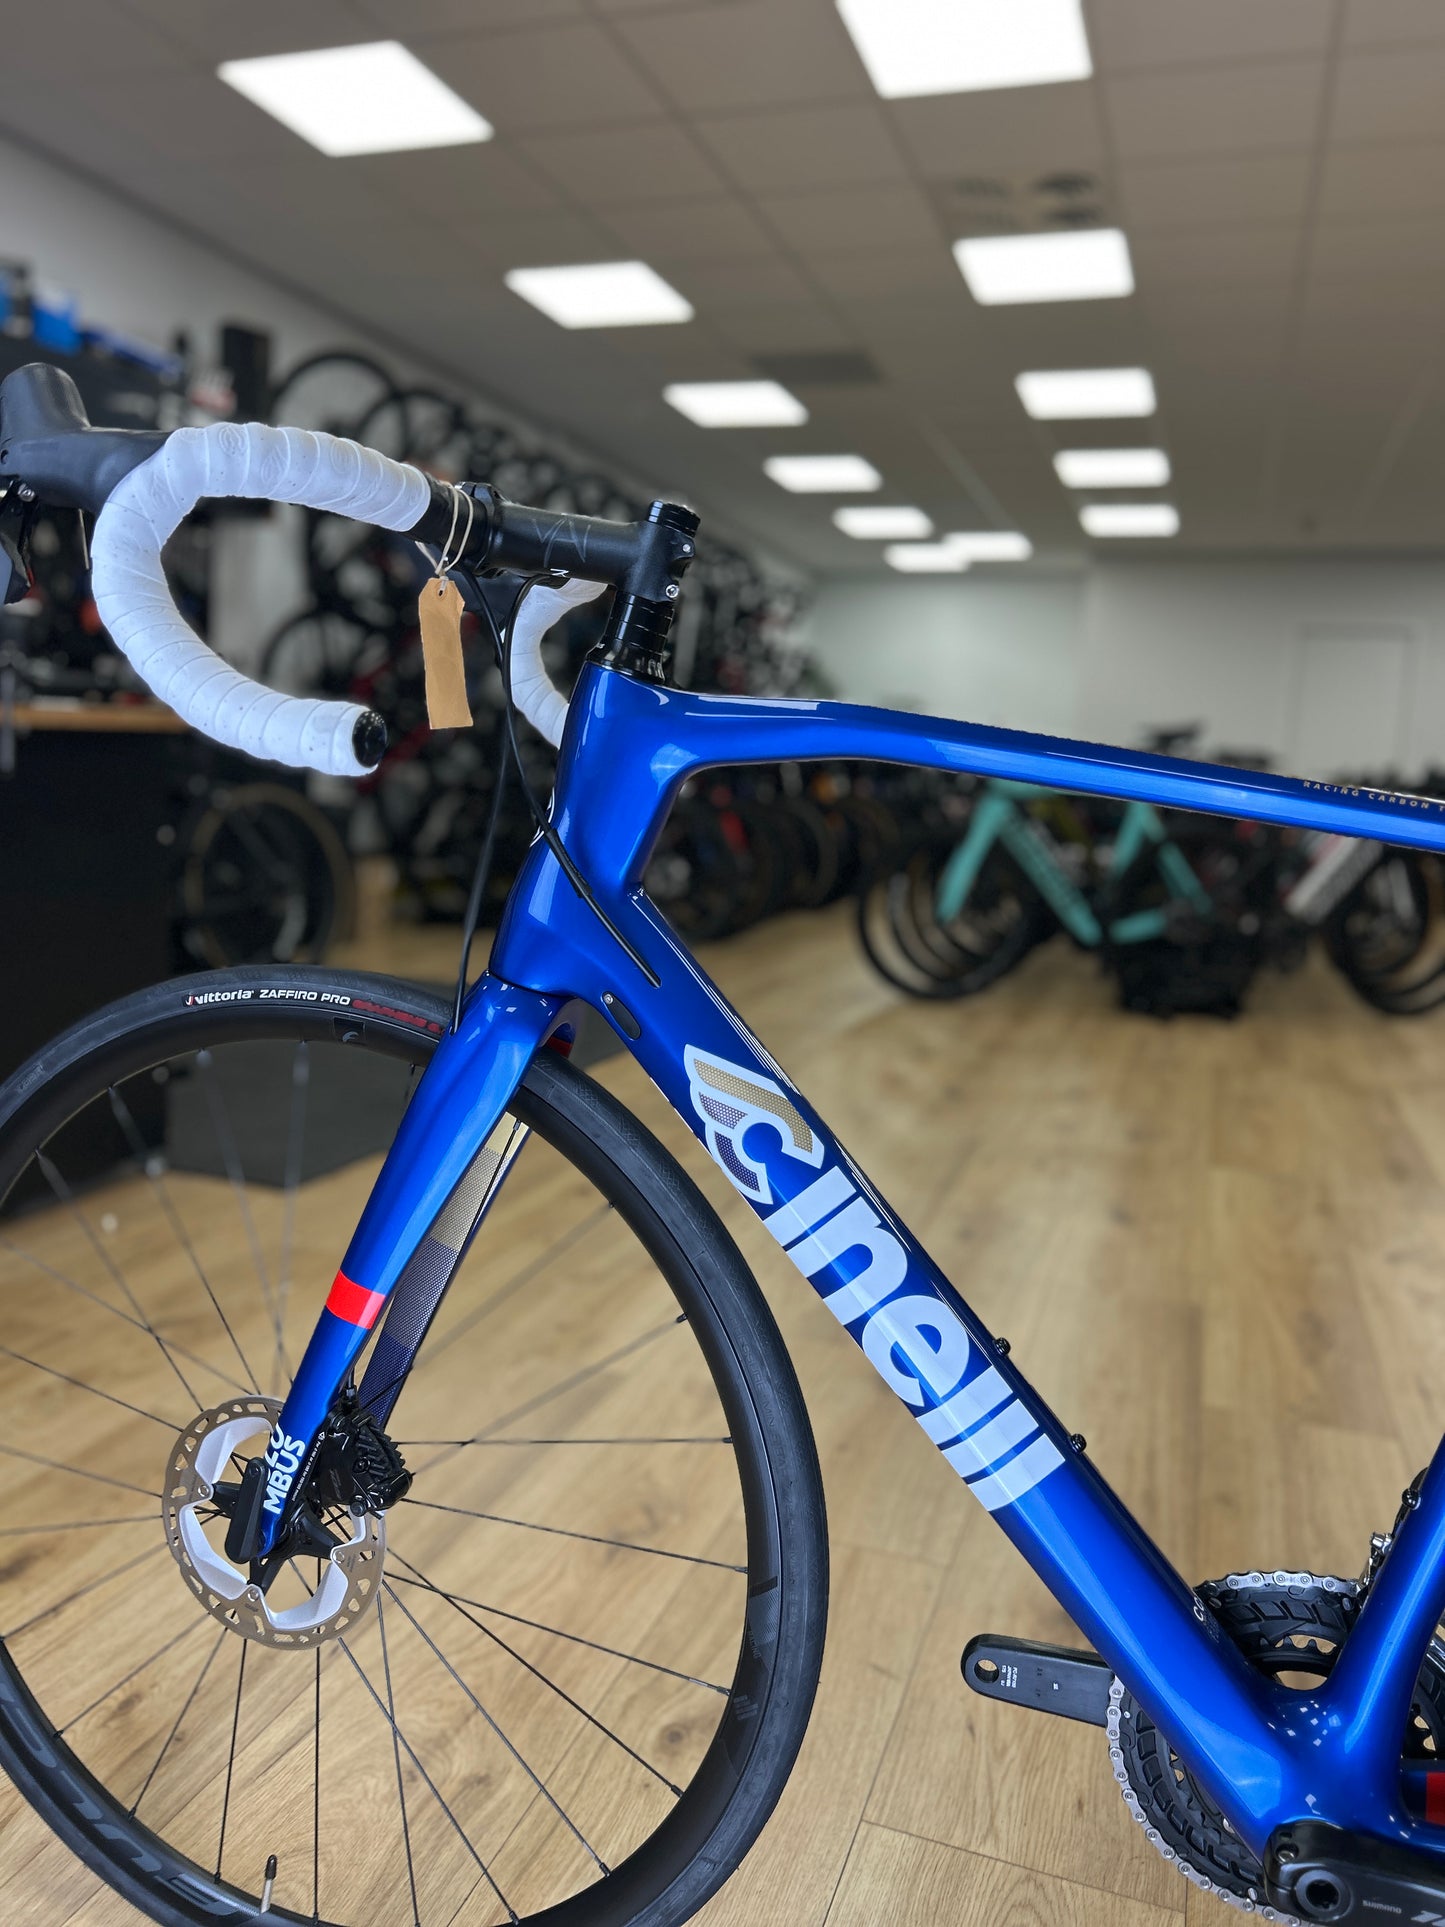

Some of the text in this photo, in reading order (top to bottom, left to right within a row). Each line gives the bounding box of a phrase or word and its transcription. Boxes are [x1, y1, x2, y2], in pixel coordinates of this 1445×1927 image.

[1303, 781, 1359, 797] RACING
[1368, 793, 1430, 809] CARBON
[194, 988, 351, 1006] vittoria ZAFFIRO PRO
[684, 1044, 1066, 1512] cinelli
[263, 1435, 306, 1514] MBUS
